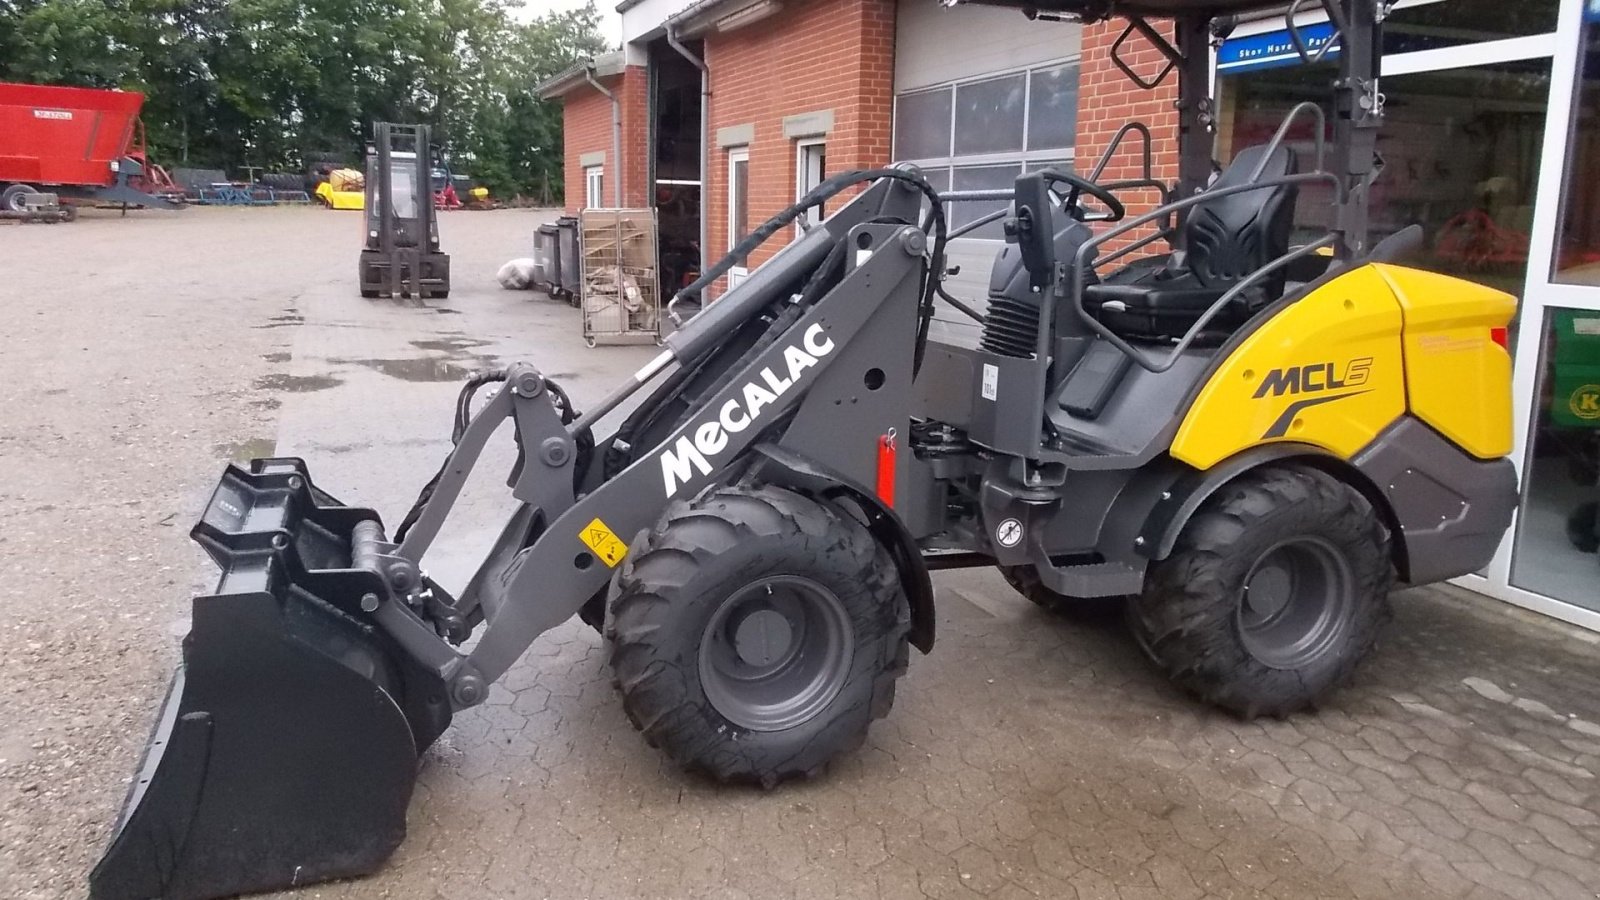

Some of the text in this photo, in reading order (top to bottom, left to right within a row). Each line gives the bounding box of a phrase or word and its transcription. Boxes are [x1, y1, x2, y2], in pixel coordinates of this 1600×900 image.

[1239, 35, 1332, 58] Skov Have Par
[1252, 357, 1374, 399] MCL6
[1580, 394, 1599, 410] K
